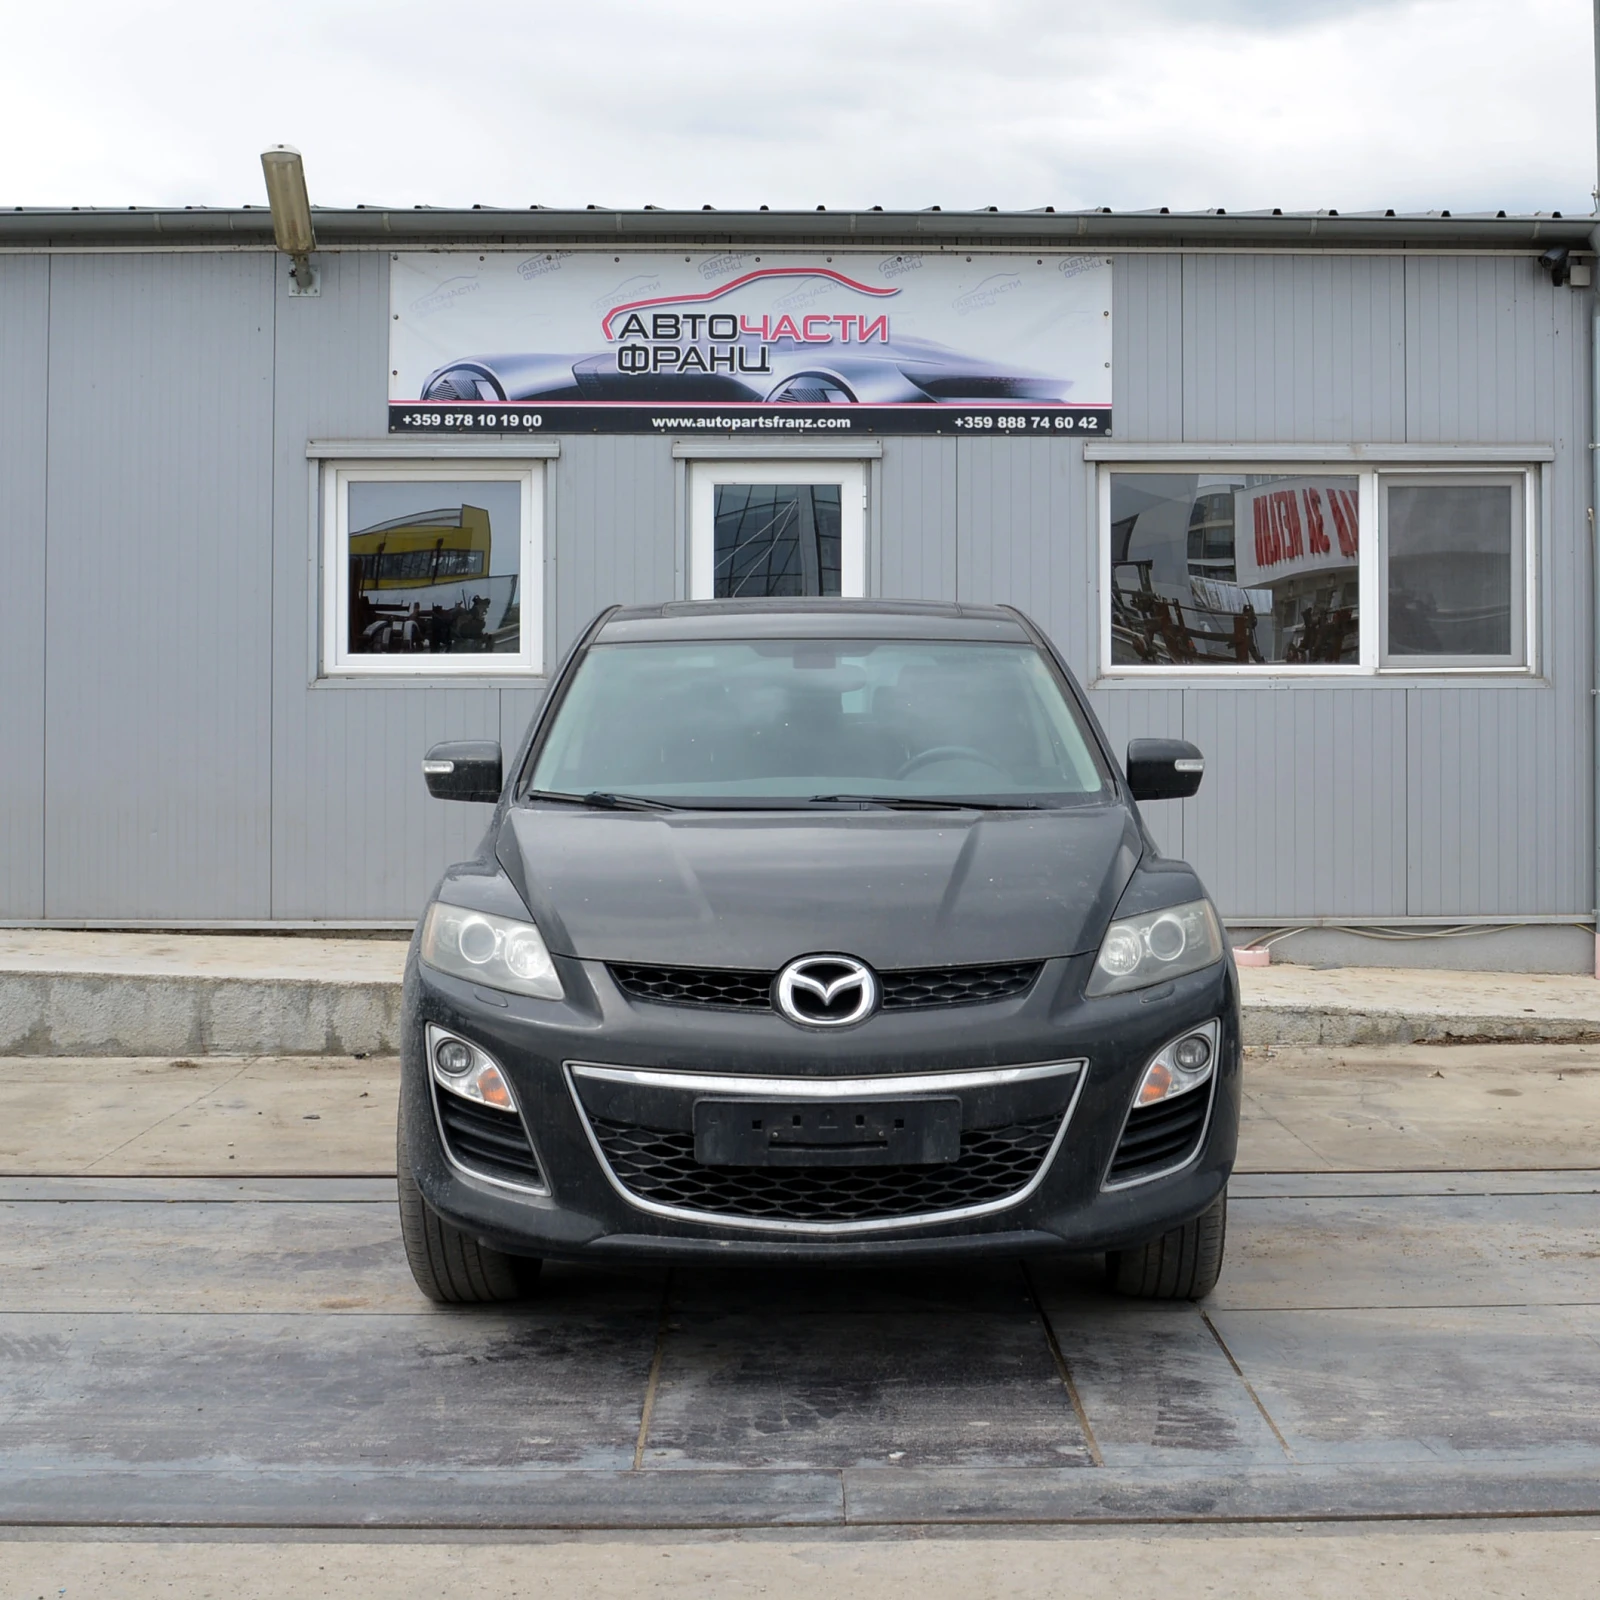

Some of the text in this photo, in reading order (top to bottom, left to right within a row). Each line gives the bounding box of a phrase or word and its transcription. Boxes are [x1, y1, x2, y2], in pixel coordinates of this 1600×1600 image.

[618, 314, 887, 341] АВТОЧАСТИ
[617, 343, 770, 373] ФРАНЦ
[402, 413, 542, 426] +359 878 10 19 00
[652, 416, 851, 430] www.autopartsfranz.com
[955, 416, 1098, 429] +359 888 74 60 42
